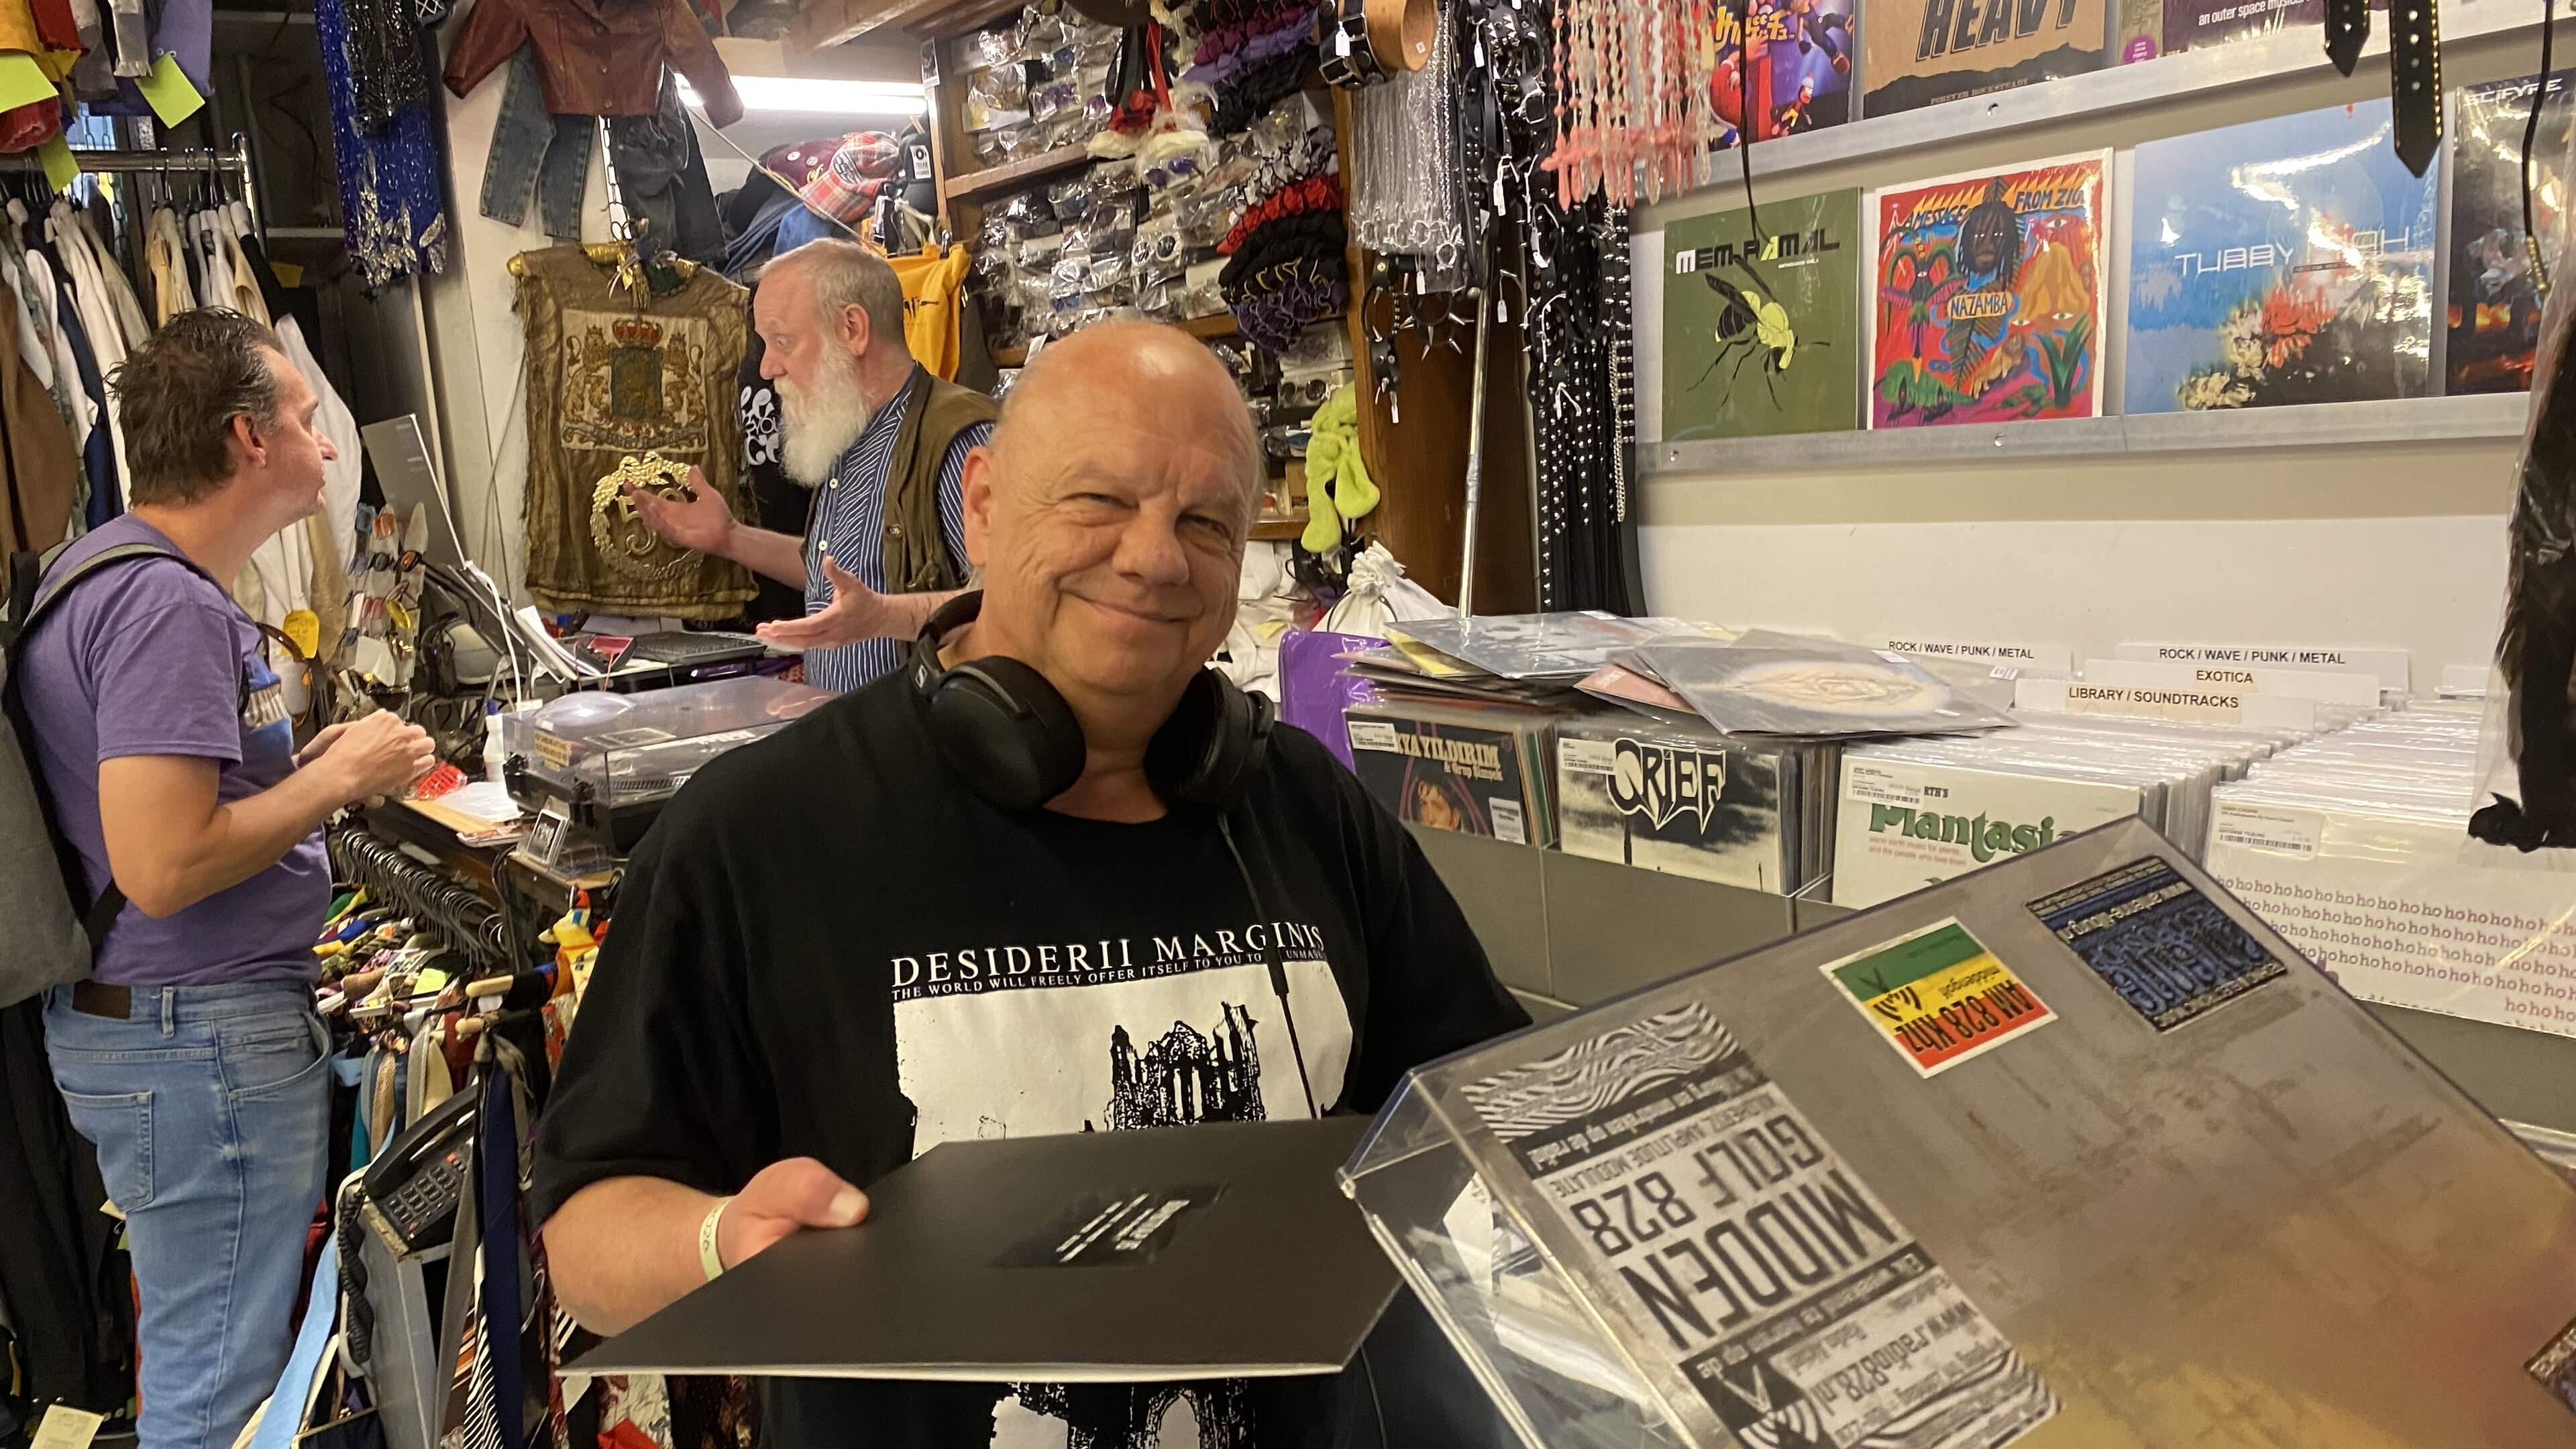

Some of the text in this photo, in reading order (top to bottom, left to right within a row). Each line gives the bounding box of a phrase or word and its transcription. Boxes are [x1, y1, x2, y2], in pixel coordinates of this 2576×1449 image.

[2198, 14, 2210, 25] an
[2212, 7, 2237, 23] outer
[2237, 1, 2265, 19] space
[2015, 190, 2052, 211] FROM
[2175, 242, 2294, 276] TUBBY
[1951, 292, 2009, 318] NAZAMBA
[1889, 641, 2034, 659] ROCK / WAVE / PUNK / METAL
[2159, 649, 2345, 664] ROCK / WAVE / PUNK / METAL
[2196, 669, 2253, 684] EXOTICA
[2069, 688, 2239, 708] LIBRARY / SOUNDTRACKS
[891, 922, 1324, 987] DESIDERII MARGINIS
[892, 986, 922, 1001] THE
[928, 981, 983, 996] WORLD
[989, 977, 1026, 989] WILL
[1031, 973, 1081, 987] FREELY
[1088, 969, 1136, 983] OFFER
[1142, 961, 1189, 977] ITSELF
[1194, 957, 1210, 969] TO
[1216, 954, 1241, 967] YOU
[1247, 953, 1262, 963] TO
[1893, 980, 2034, 1053] AM 828 Khz
[1627, 1124, 1705, 1169] AMPLITUDE
[1550, 1151, 1631, 1198] MODULATIE
[1570, 1114, 1824, 1257] GOLF 828
[1617, 1170, 1898, 1350] MIDDEN
[1696, 1356, 1726, 1381] de
[1814, 1299, 1980, 1416] www.radio828.nl
